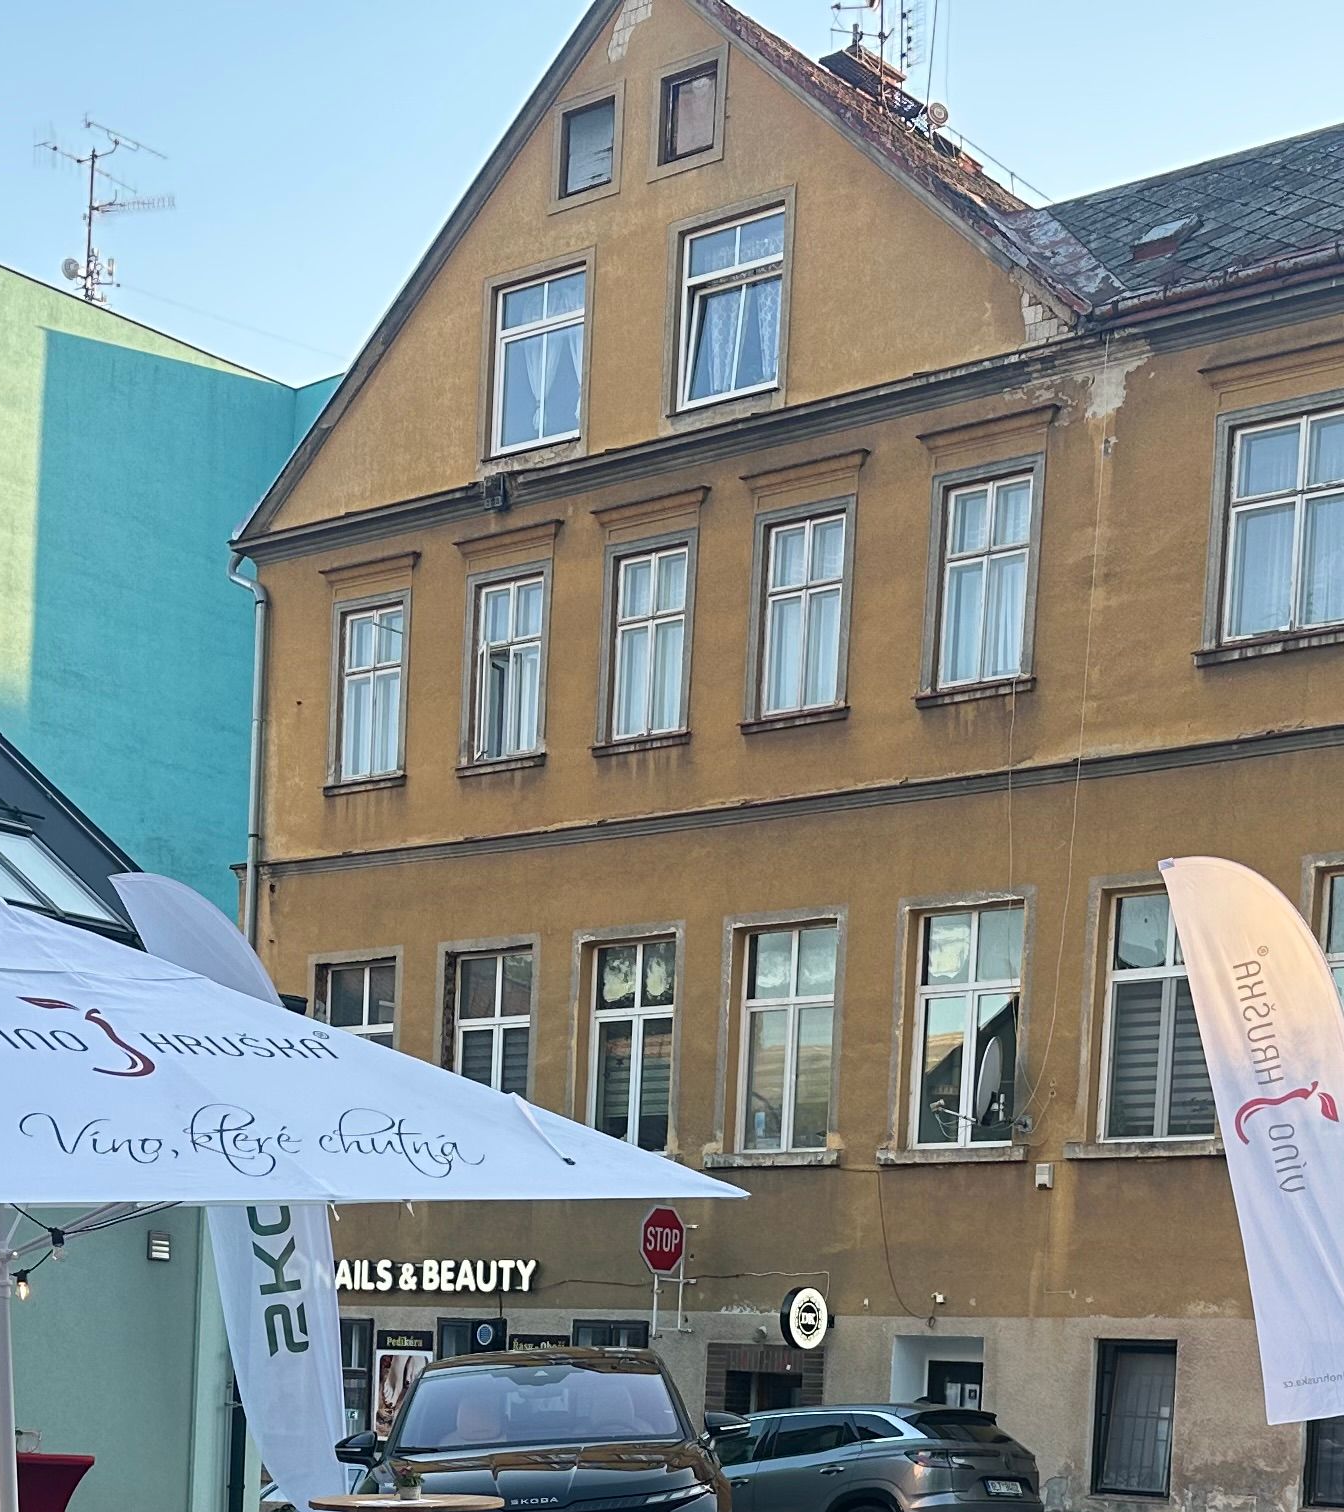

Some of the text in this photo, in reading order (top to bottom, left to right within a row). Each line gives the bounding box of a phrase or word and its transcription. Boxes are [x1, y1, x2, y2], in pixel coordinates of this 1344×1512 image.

[19, 1103, 485, 1179] Víno, které chutná
[646, 1226, 680, 1253] STOP
[399, 1262, 416, 1291] &
[422, 1259, 537, 1292] BEAUTY
[800, 1312, 817, 1325] DK
